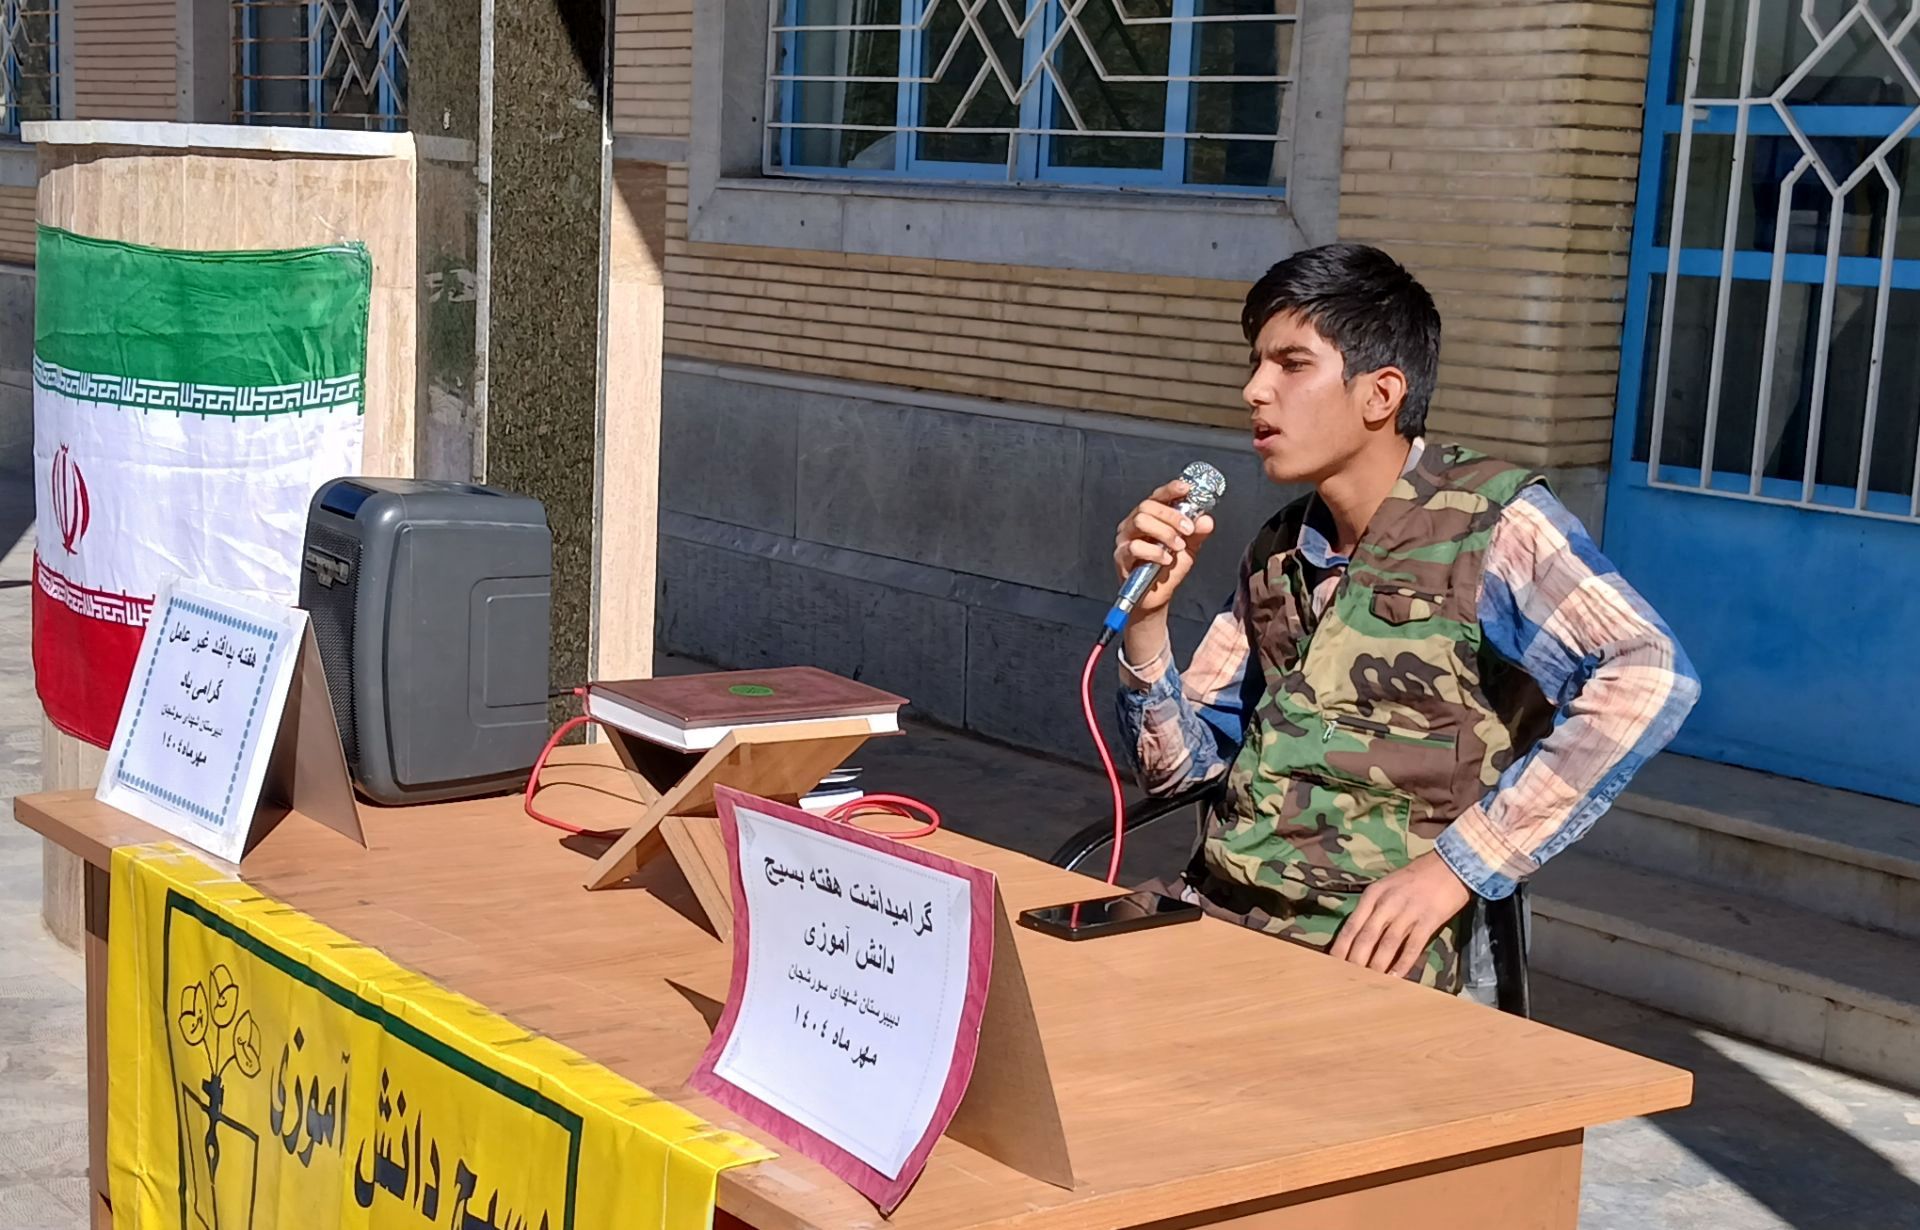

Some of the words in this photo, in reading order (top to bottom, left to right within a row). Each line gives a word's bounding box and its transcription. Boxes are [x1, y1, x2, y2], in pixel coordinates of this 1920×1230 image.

[191, 678, 224, 703] گرامی
[764, 856, 805, 890] بسیج
[809, 867, 842, 898] هفته
[804, 922, 850, 956] آموزی
[855, 938, 895, 974] دانش
[832, 1026, 850, 1051] ماه
[851, 1045, 877, 1069] مهر
[269, 1026, 351, 1168] آموزی
[354, 1066, 441, 1221] دانش
